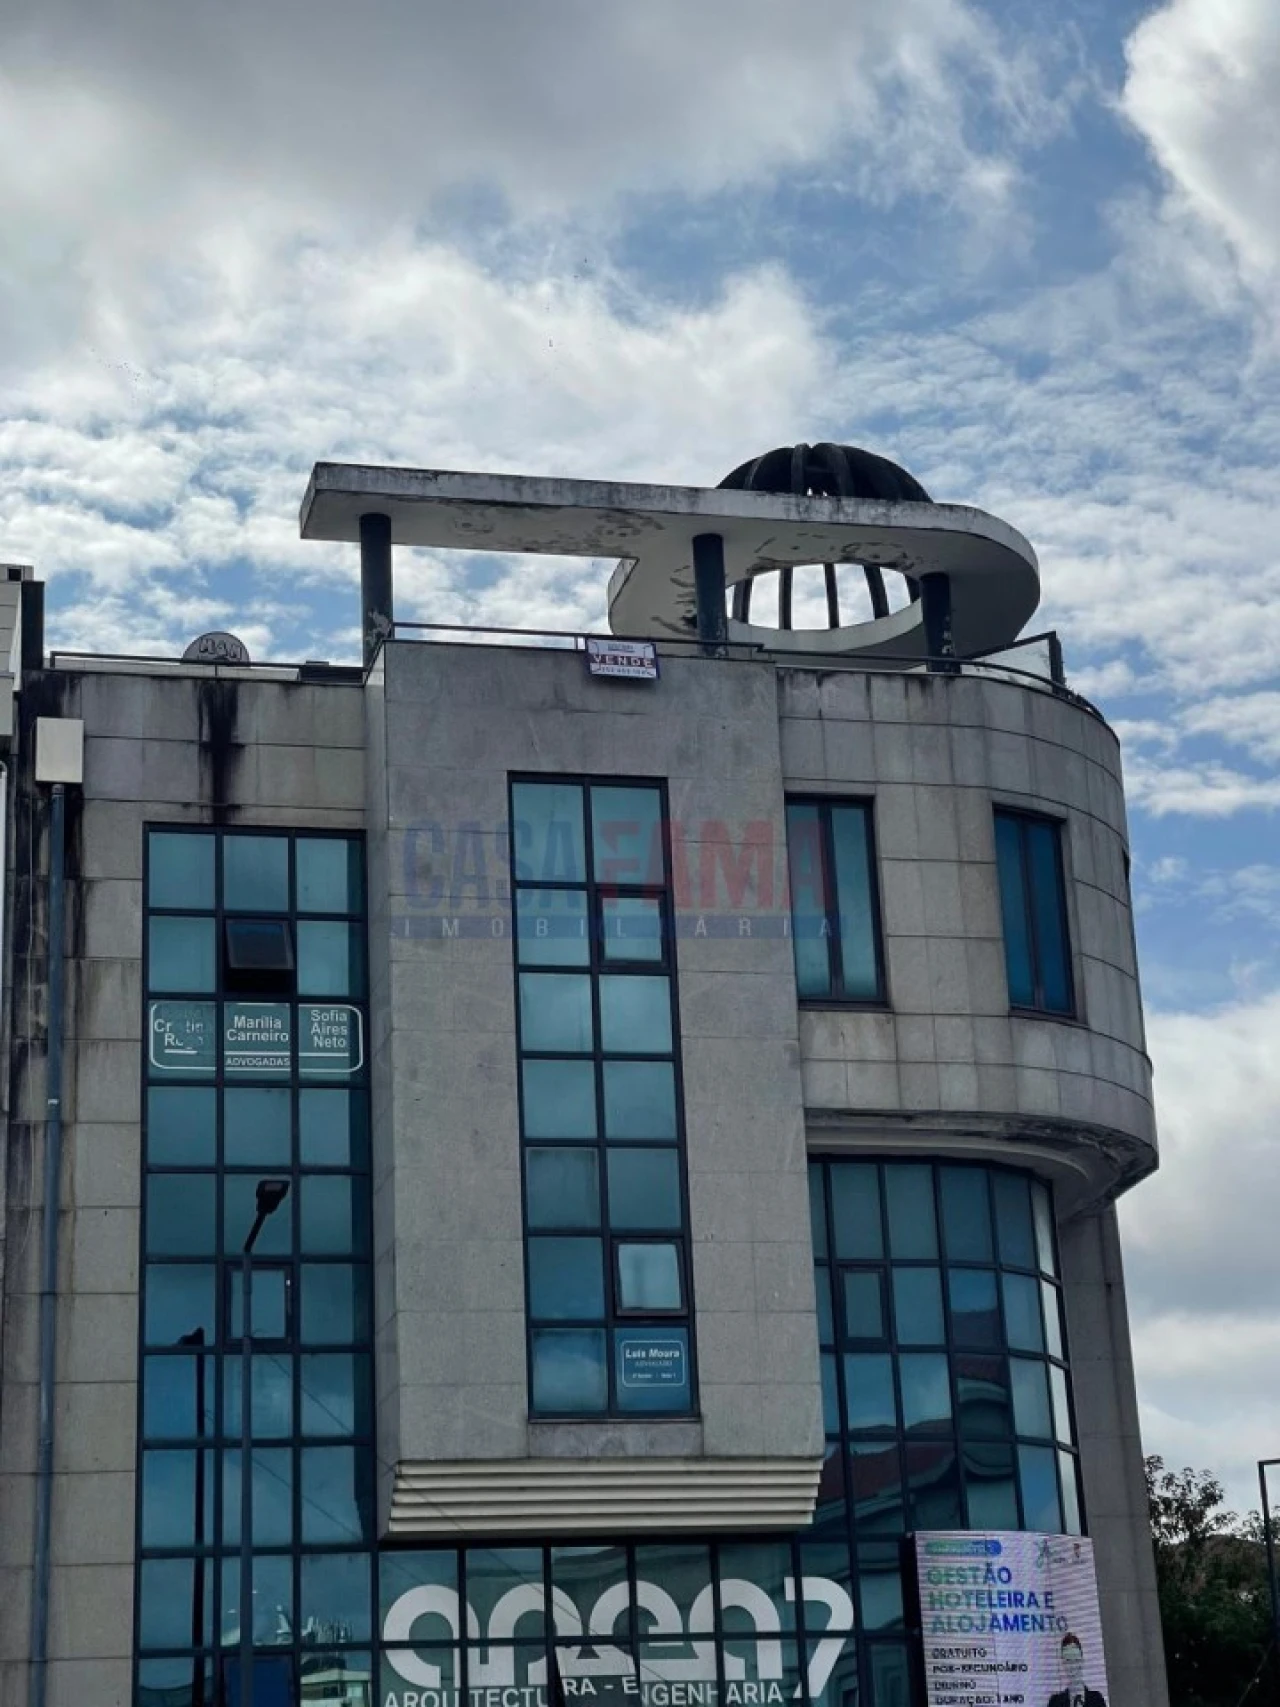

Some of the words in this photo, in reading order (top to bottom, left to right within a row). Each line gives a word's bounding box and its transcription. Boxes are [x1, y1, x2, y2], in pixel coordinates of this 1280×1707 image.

[594, 655, 653, 668] VENDE
[310, 1009, 348, 1022] Sofia
[227, 1028, 289, 1042] Carneiro
[310, 1022, 348, 1036] Aires
[314, 1035, 346, 1048] Neto
[226, 1057, 290, 1066] ADVOGADAS
[927, 1562, 1012, 1585] GESTÃO
[929, 1589, 1040, 1611] HOTELEIRA
[1044, 1590, 1055, 1610] E
[931, 1613, 1068, 1633] ALOJAMENTO
[931, 1647, 987, 1659] GRATUITO
[384, 1678, 598, 1707] ARQUTECTURA
